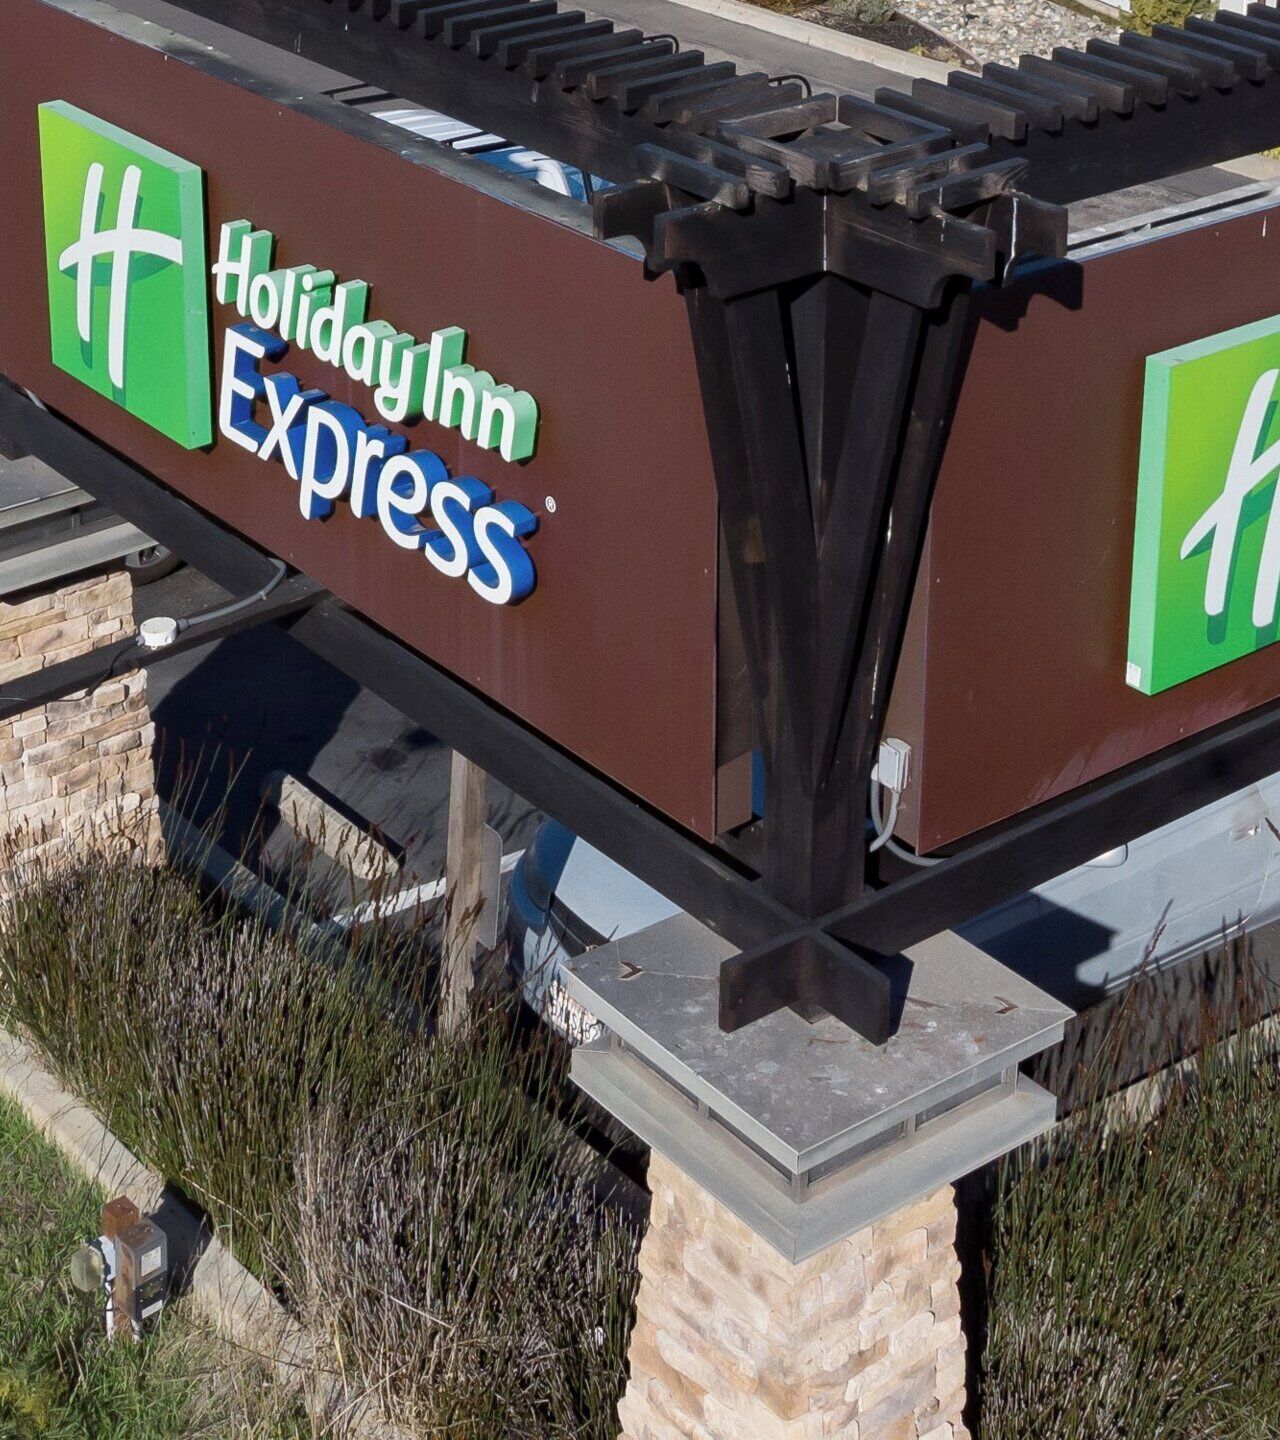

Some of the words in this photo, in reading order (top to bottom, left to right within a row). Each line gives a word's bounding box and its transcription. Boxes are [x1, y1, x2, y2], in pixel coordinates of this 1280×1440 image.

[211, 221, 432, 426] Holiday
[423, 328, 526, 462] Inn
[219, 325, 528, 606] Express
